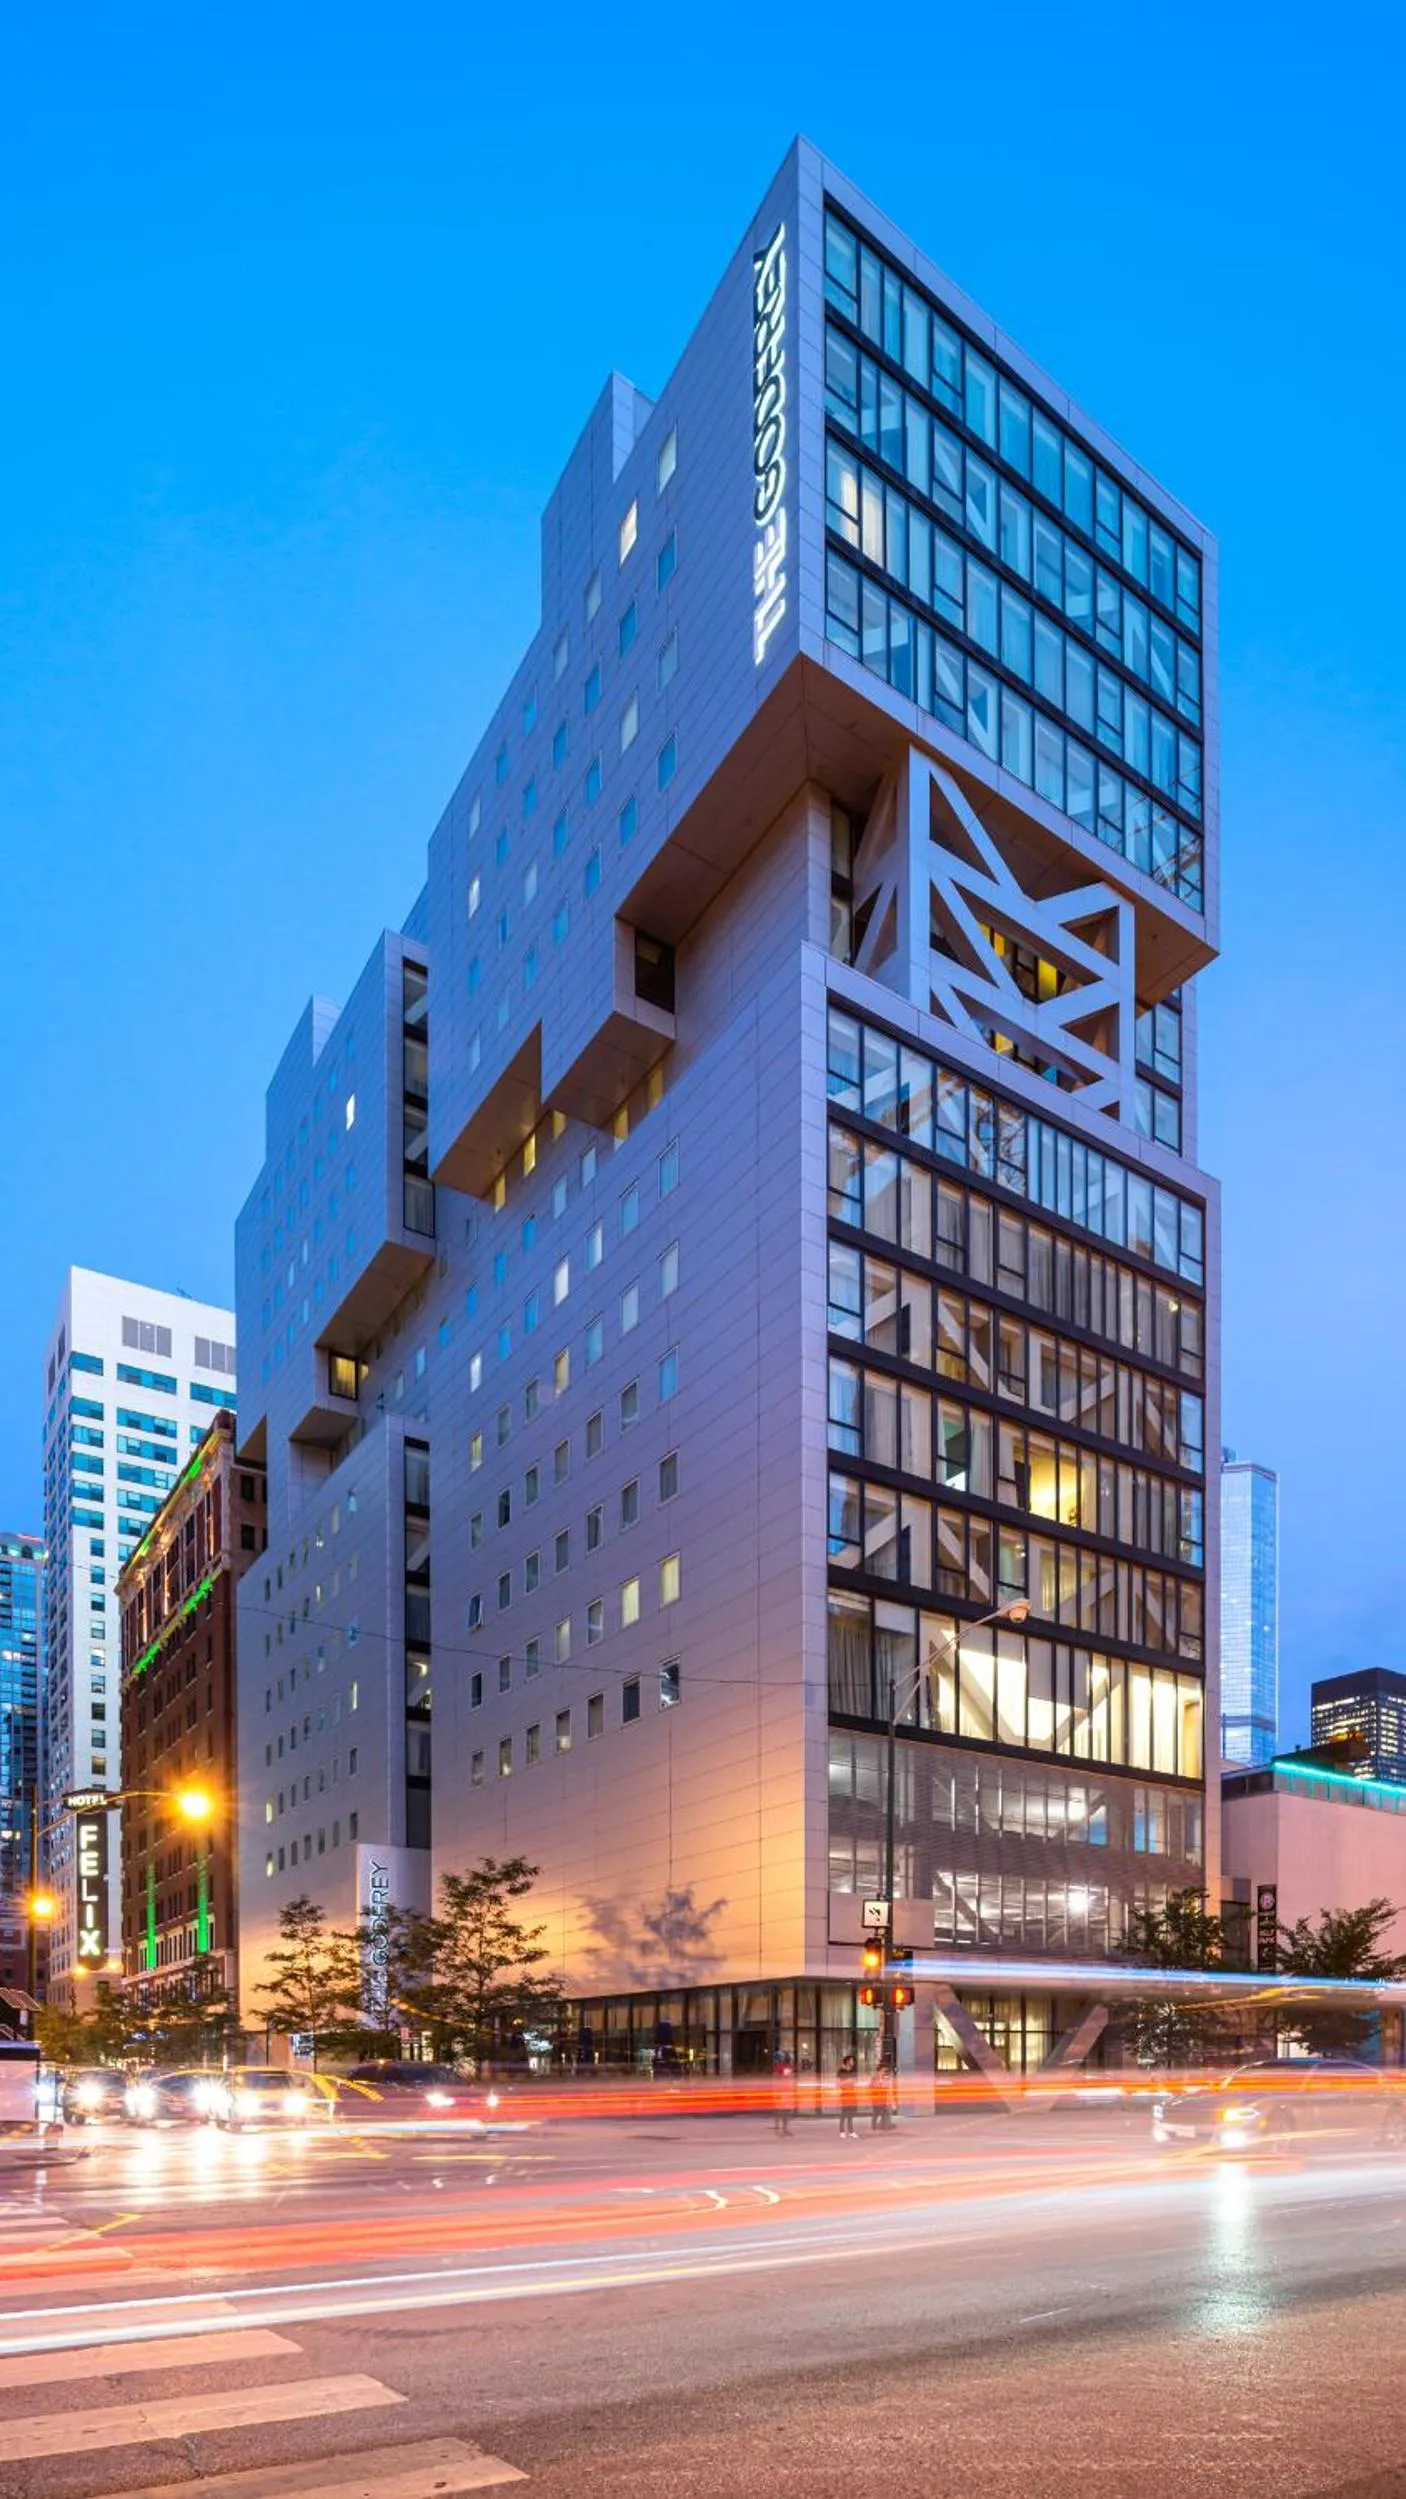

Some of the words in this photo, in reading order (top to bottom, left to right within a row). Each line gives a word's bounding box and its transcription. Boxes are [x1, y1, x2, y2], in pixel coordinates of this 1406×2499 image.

[753, 222, 786, 526] GODFREY
[753, 507, 786, 667] THE
[67, 1794, 107, 1807] HOTEL
[80, 1824, 100, 1956] FELIX
[370, 1860, 389, 1966] GODFREY
